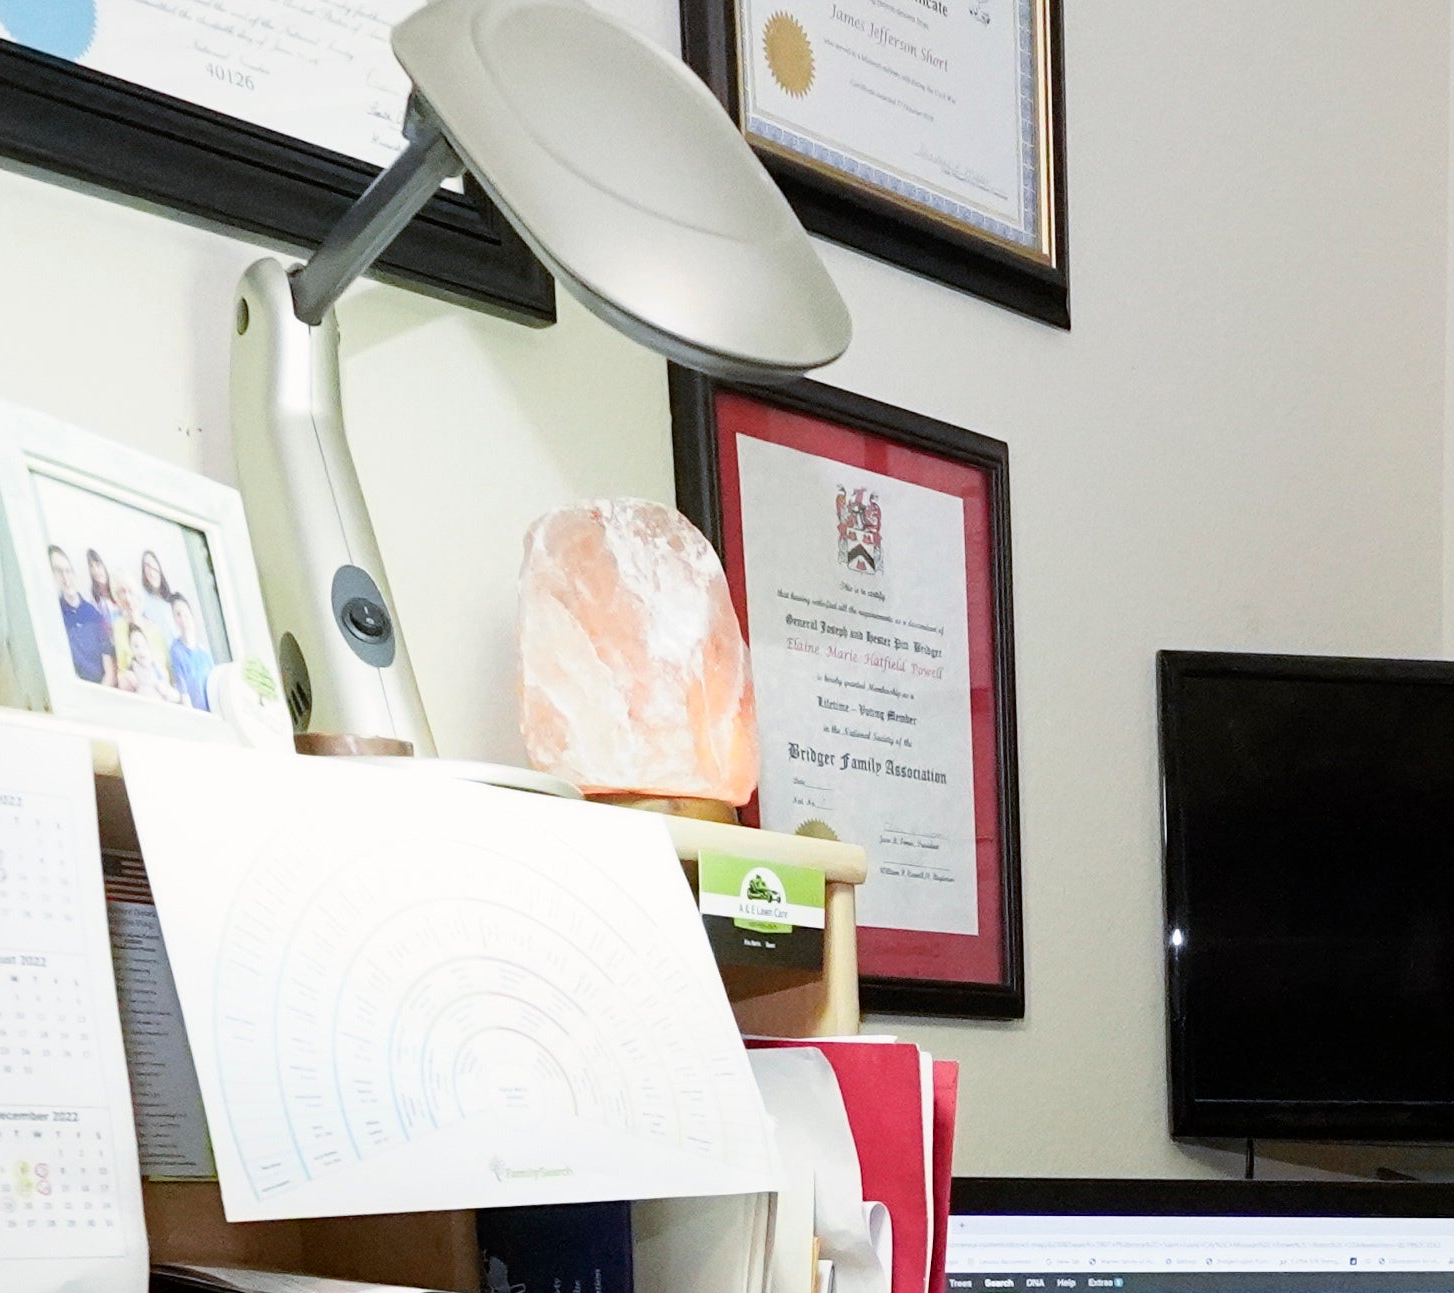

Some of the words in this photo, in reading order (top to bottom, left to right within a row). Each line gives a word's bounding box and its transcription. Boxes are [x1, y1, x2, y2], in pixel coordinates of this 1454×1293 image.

[831, 3, 865, 32] James
[868, 18, 918, 58] Jefferson
[920, 45, 949, 73] Short
[205, 62, 255, 91] 40126
[820, 621, 849, 640] Joseph
[786, 637, 821, 656] Elaine
[826, 645, 859, 663] Marie
[864, 652, 906, 673] Hatfield
[910, 662, 945, 681] Powell
[788, 742, 836, 768] Bridger
[839, 753, 883, 777] Family
[885, 759, 947, 785] Association
[773, 908, 788, 919] Care
[949, 1278, 972, 1288] Trees
[984, 1278, 1014, 1288] Search
[1026, 1278, 1045, 1288] DNA
[1056, 1278, 1076, 1289] Help
[1088, 1278, 1113, 1288] Extras
